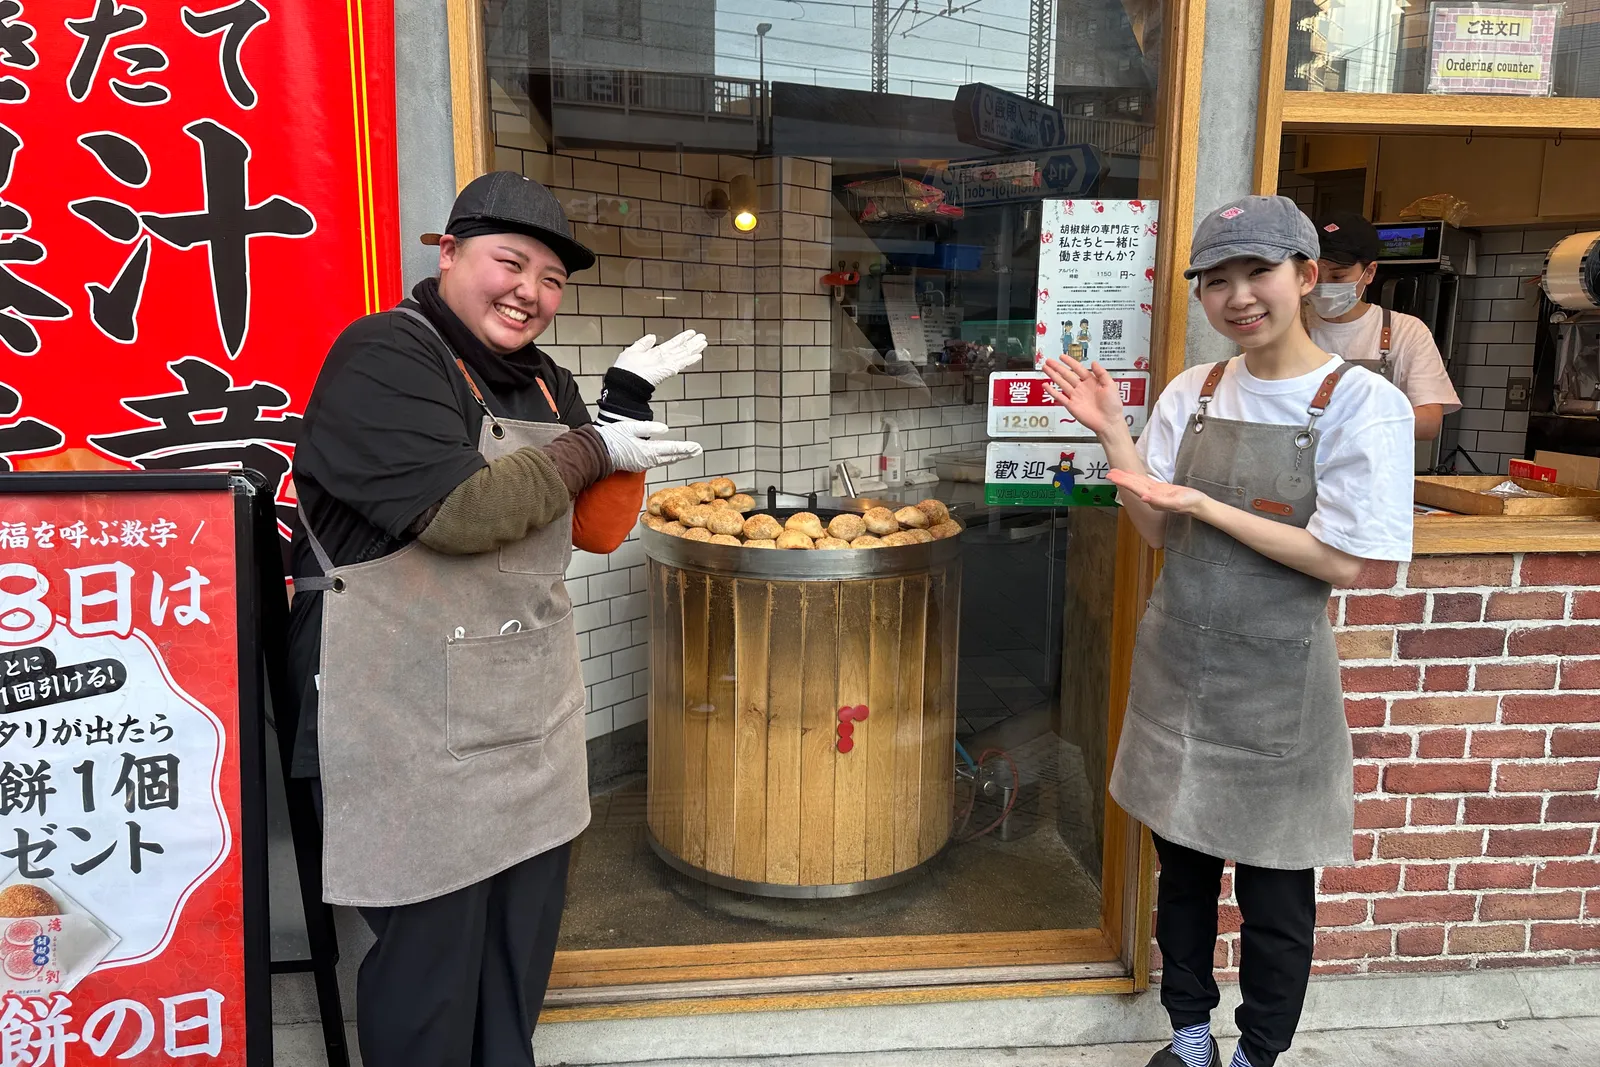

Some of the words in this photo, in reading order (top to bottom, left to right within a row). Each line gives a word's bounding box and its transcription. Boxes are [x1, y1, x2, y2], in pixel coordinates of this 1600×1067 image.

[1467, 19, 1521, 37] ご注文口
[1446, 58, 1493, 73] Ordering
[1497, 60, 1534, 74] counter
[1060, 224, 1140, 235] 胡椒餅の専門店で
[1059, 236, 1139, 248] 私たちと一緒に
[1002, 415, 1049, 428] 12:00
[994, 460, 1045, 480] 歡迎
[996, 489, 1057, 499] WELCOME
[0, 519, 178, 549] 福を呼ぶ数字
[0, 752, 180, 817] 餅1個
[0, 822, 164, 879] ゼント
[0, 989, 225, 1067] 餅の日
